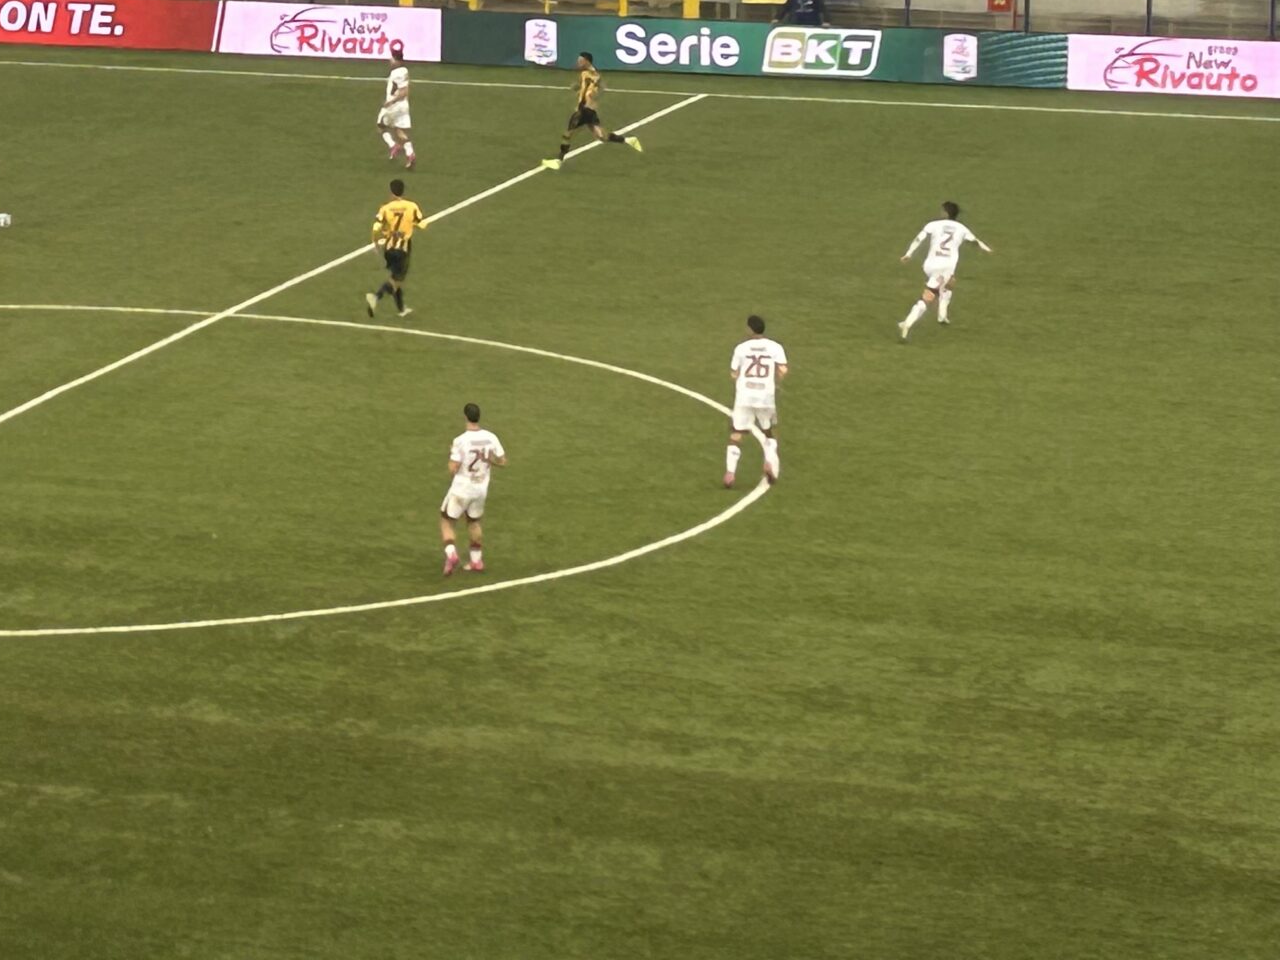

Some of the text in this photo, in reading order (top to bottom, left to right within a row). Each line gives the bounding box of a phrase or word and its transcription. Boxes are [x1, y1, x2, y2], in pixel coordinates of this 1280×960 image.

[67, 3, 124, 36] TE.
[342, 18, 381, 35] New
[296, 24, 404, 54] Rivauto
[615, 23, 876, 70] Serie BKT
[1186, 51, 1232, 70] New
[1131, 57, 1258, 92] Rivauto
[393, 212, 404, 231] 7
[940, 231, 954, 251] 2
[744, 354, 772, 378] 26
